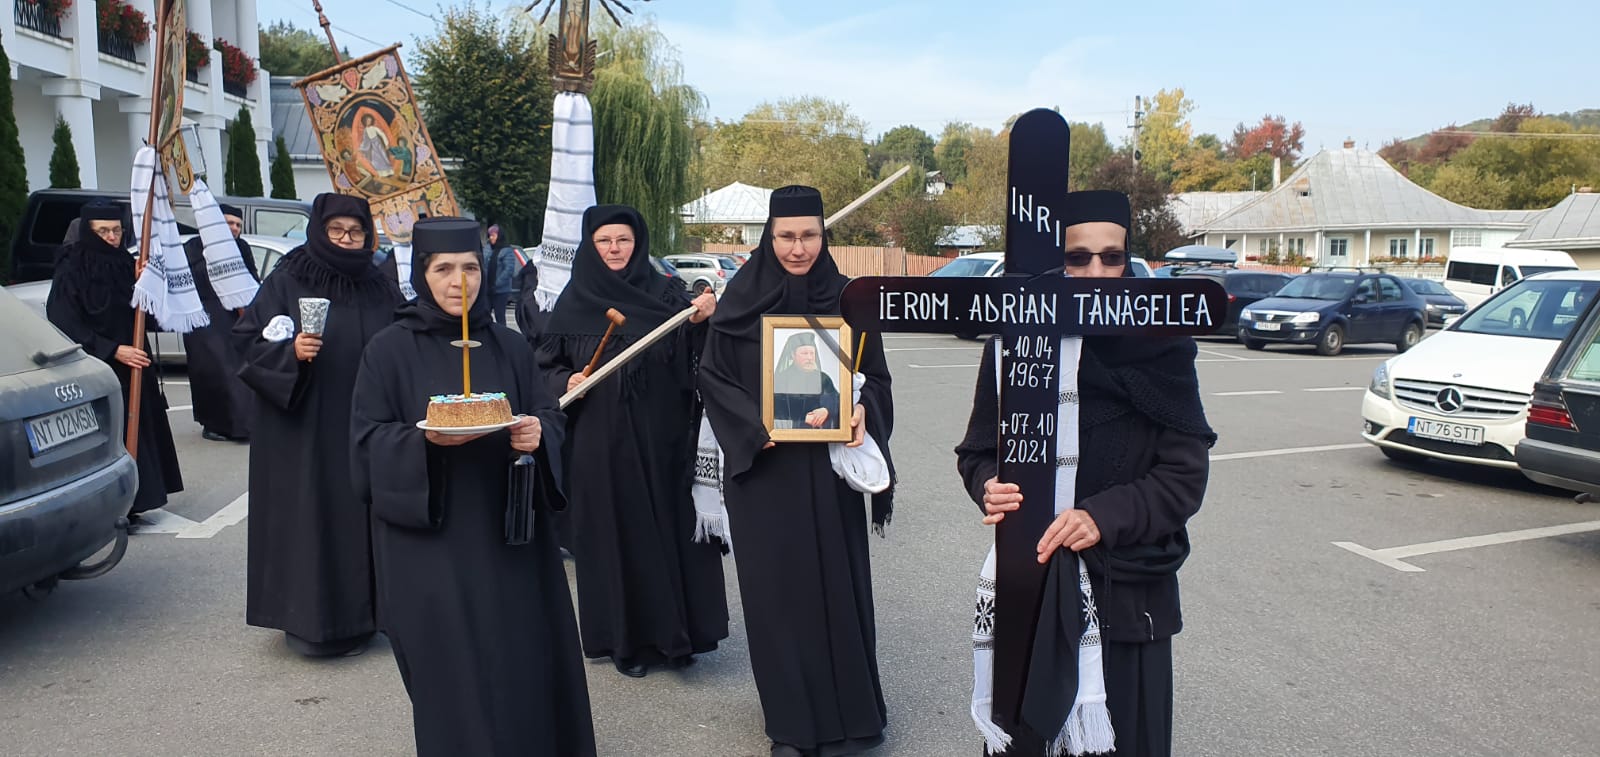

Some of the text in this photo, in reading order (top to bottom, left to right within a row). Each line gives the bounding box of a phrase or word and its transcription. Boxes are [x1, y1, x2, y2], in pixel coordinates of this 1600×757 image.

[1011, 186, 1061, 248] INRI
[1008, 361, 1055, 389] 1967
[32, 419, 54, 447] NT
[1416, 420, 1479, 440] NT 76 STT
[1004, 438, 1048, 464] 2021
